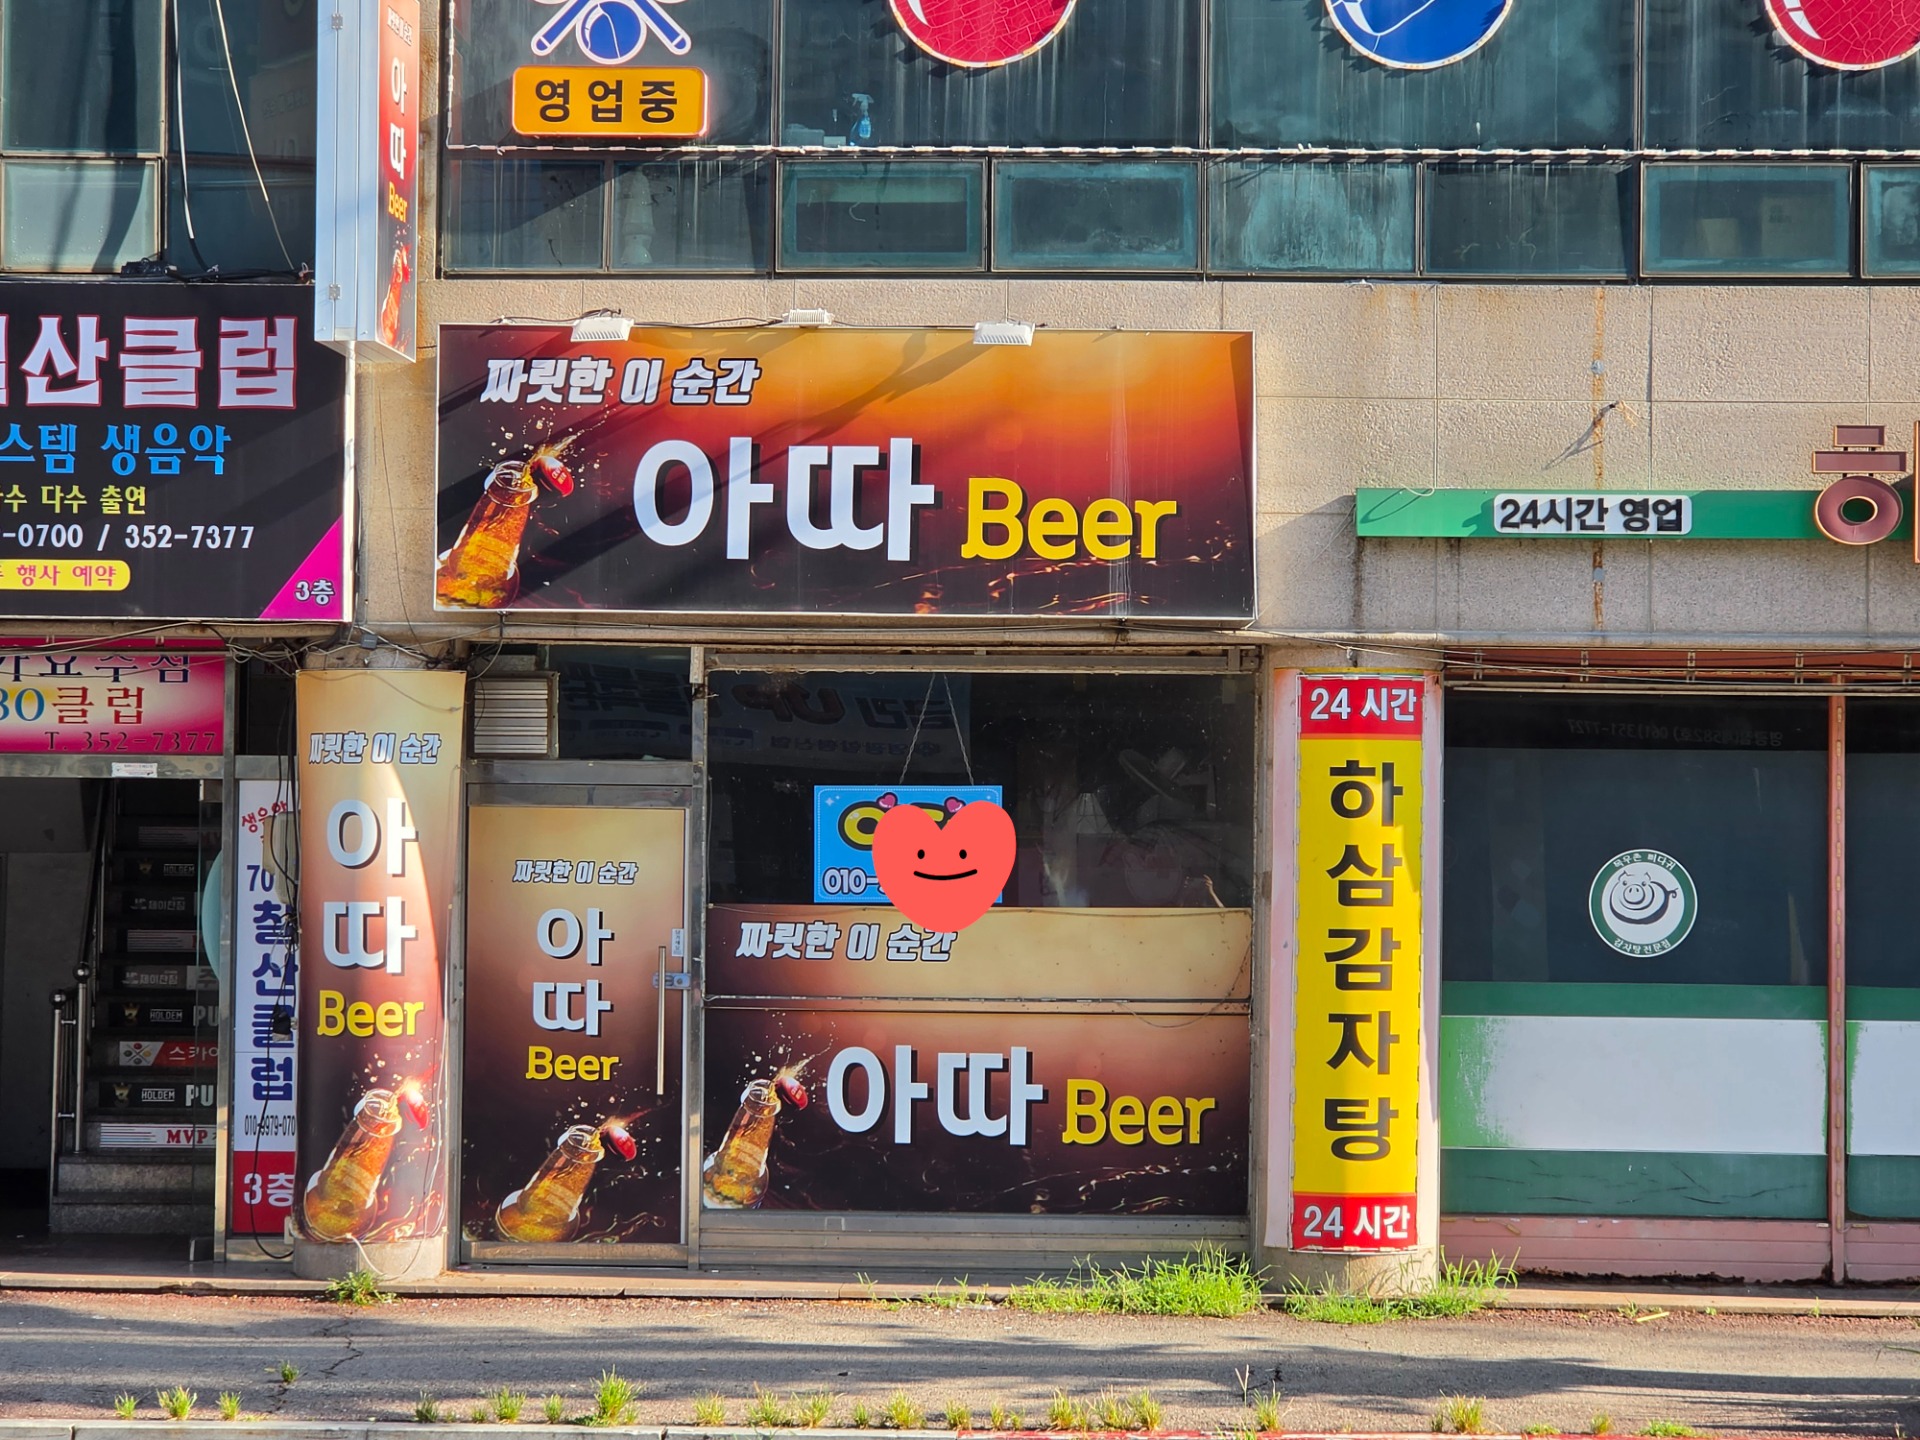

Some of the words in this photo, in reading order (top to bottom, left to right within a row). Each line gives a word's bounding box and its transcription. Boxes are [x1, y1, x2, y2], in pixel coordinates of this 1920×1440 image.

[390, 57, 407, 180] 아따
[387, 182, 410, 222] Beer
[480, 357, 613, 405] 짜릿한
[620, 358, 656, 403] 이
[671, 358, 761, 406] 순간
[101, 423, 231, 475] 생음악
[41, 485, 87, 514] 다수
[100, 485, 146, 515] 출연
[632, 436, 937, 562] 아따
[960, 477, 1179, 562] Beer
[1500, 497, 1607, 532] 24시간
[1619, 497, 1683, 533] 영업
[125, 525, 254, 549] 352-7377
[17, 564, 60, 586] 행사
[72, 565, 117, 587] 예약
[294, 579, 335, 605] 3층
[1310, 688, 1351, 721] 24
[1361, 686, 1417, 723] 시간
[44, 731, 67, 750] T.
[85, 731, 217, 751] 352-7377
[309, 731, 367, 765] 짜릿한
[371, 732, 396, 764] 이
[399, 732, 442, 765] 순간
[322, 797, 418, 976] 아따
[512, 859, 572, 883] 짜릿한
[575, 861, 595, 884] 이
[598, 861, 638, 885] 순간
[735, 920, 840, 961] 짜릿한
[846, 923, 880, 961] 이
[887, 924, 960, 963] 순간
[532, 907, 614, 1037] 아따
[1323, 758, 1404, 1162] 하삼감자탕
[150, 1010, 183, 1020] HOLDEM
[317, 990, 424, 1038] Beer
[525, 1045, 620, 1082] Beer
[141, 1090, 175, 1101] HOLDEM
[827, 1045, 1044, 1146] 아따
[1062, 1078, 1216, 1146] Beer
[166, 1130, 208, 1143] MVP
[243, 1173, 295, 1208] 3층
[1303, 1205, 1345, 1238] 24
[1354, 1204, 1410, 1239] 시간
